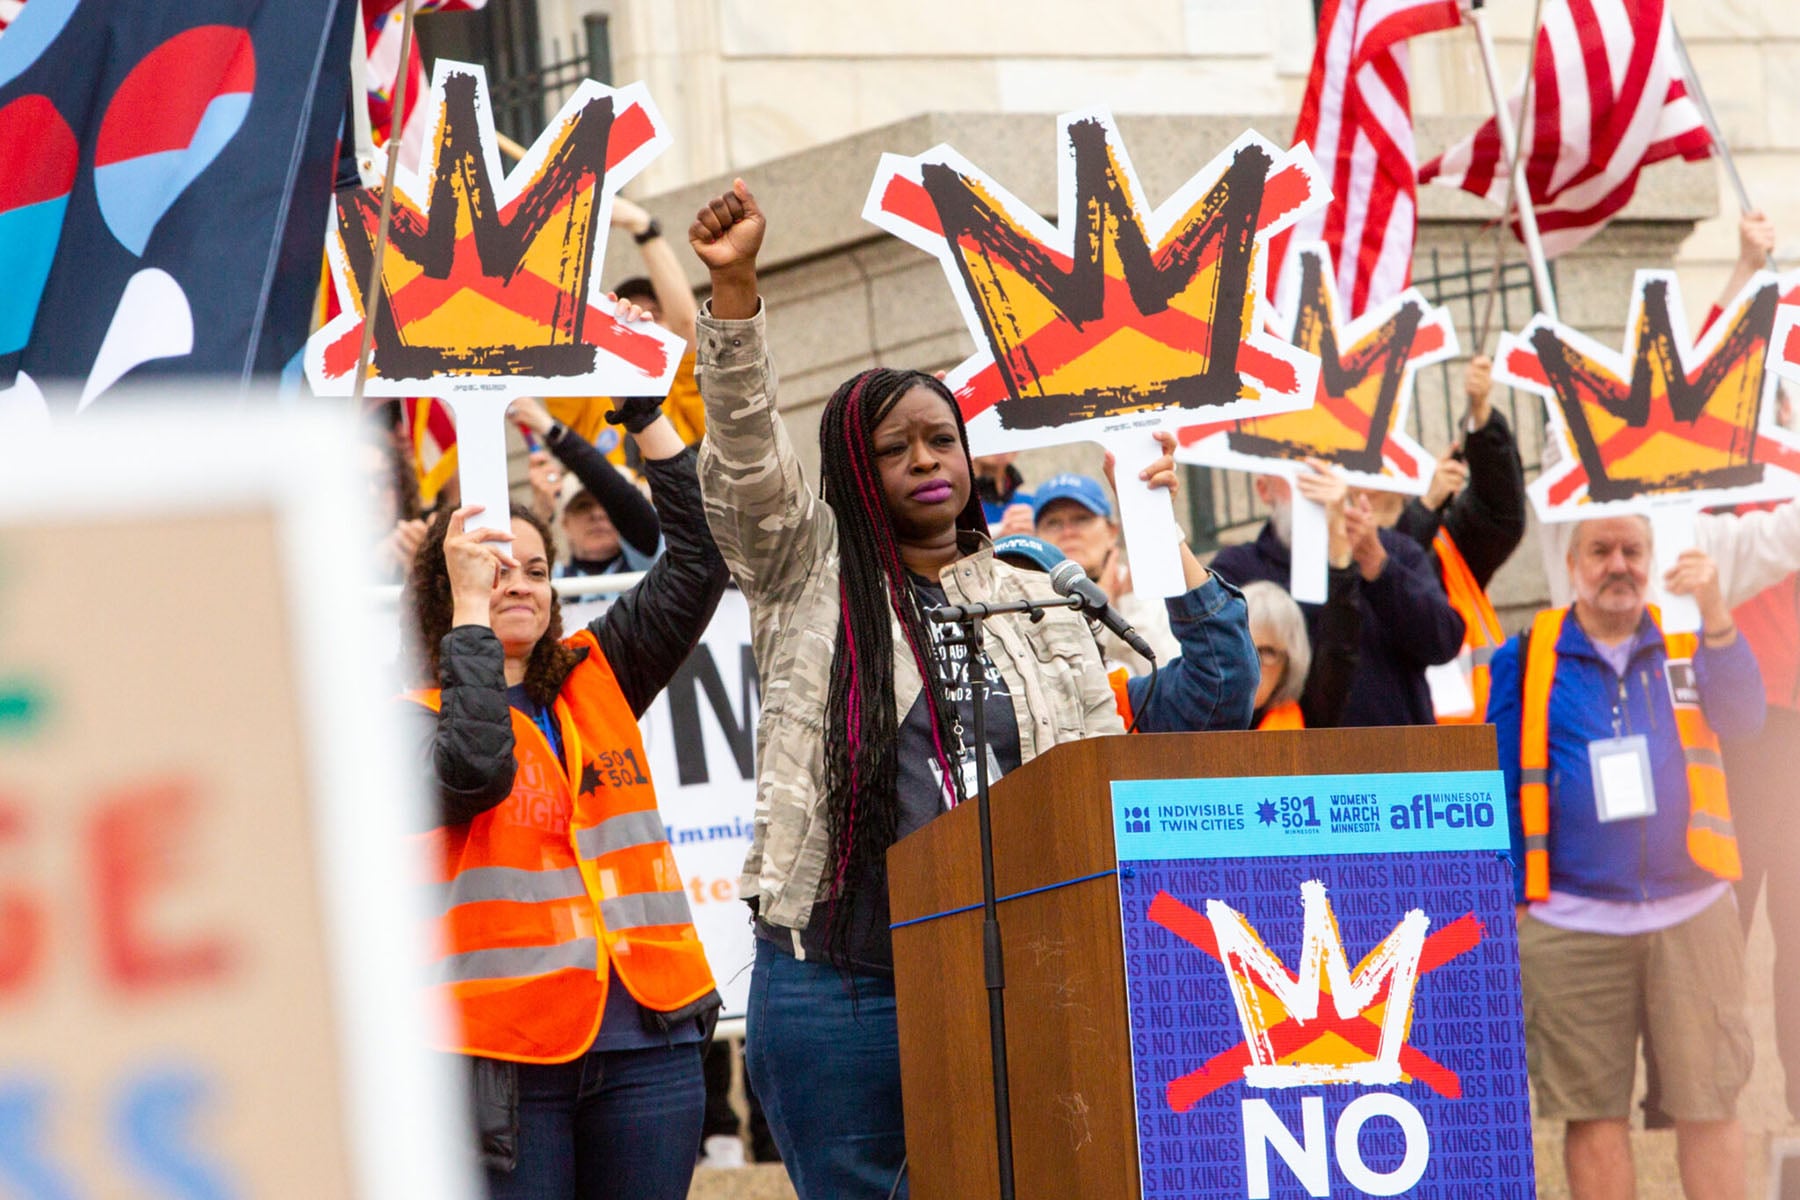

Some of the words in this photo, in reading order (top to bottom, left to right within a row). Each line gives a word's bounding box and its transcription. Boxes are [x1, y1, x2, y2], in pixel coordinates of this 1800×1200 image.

[599, 751, 624, 769] 50
[608, 768, 633, 787] 50
[1280, 796, 1302, 812] 50
[1330, 794, 1377, 806] WOMEN'S
[1433, 792, 1492, 803] MINNESOTA
[1158, 804, 1245, 818] INDIVISIBLE
[1282, 813, 1304, 828] 50
[1330, 807, 1380, 822] MARCH
[1160, 819, 1198, 832] TWIN
[1201, 818, 1245, 831] CITIES
[1331, 822, 1381, 834] MINNESOTA
[1168, 870, 1218, 894] KINGS
[1224, 869, 1247, 892] NO
[1337, 865, 1388, 888] KINGS
[1393, 864, 1415, 887] NO
[1421, 862, 1471, 886] KINGS
[1475, 861, 1499, 884] NO
[1339, 893, 1390, 916] KINGS
[1423, 890, 1473, 913] KINGS
[1477, 889, 1501, 912] NO
[1146, 953, 1168, 976] NO
[1481, 942, 1505, 965] NO
[1148, 980, 1170, 1003] NO
[1176, 978, 1227, 1002] KINGS
[1429, 970, 1480, 993] KINGS
[1483, 969, 1507, 991] NO
[1150, 1004, 1172, 1027] NO
[1178, 1003, 1229, 1026] KINGS
[1431, 994, 1482, 1018] KINGS
[1485, 993, 1509, 1016] NO
[1152, 1031, 1174, 1054] NO
[1433, 1021, 1484, 1045] KINGS
[1487, 1020, 1511, 1043] NO
[1490, 1047, 1513, 1070] NO
[1492, 1074, 1516, 1097] NO
[1158, 1113, 1180, 1136] NO
[1186, 1111, 1237, 1135] KINGS
[1440, 1102, 1490, 1125] KINGS
[1494, 1100, 1518, 1123] NO
[1160, 1140, 1182, 1163] NO
[1188, 1138, 1239, 1162] KINGS
[1442, 1129, 1492, 1152] KINGS
[1496, 1127, 1520, 1150] NO
[1241, 1092, 1430, 1199] NO
[1162, 1167, 1184, 1190] NO
[1191, 1165, 1241, 1189] KINGS
[1444, 1156, 1495, 1179] KINGS
[1498, 1154, 1522, 1177] NO
